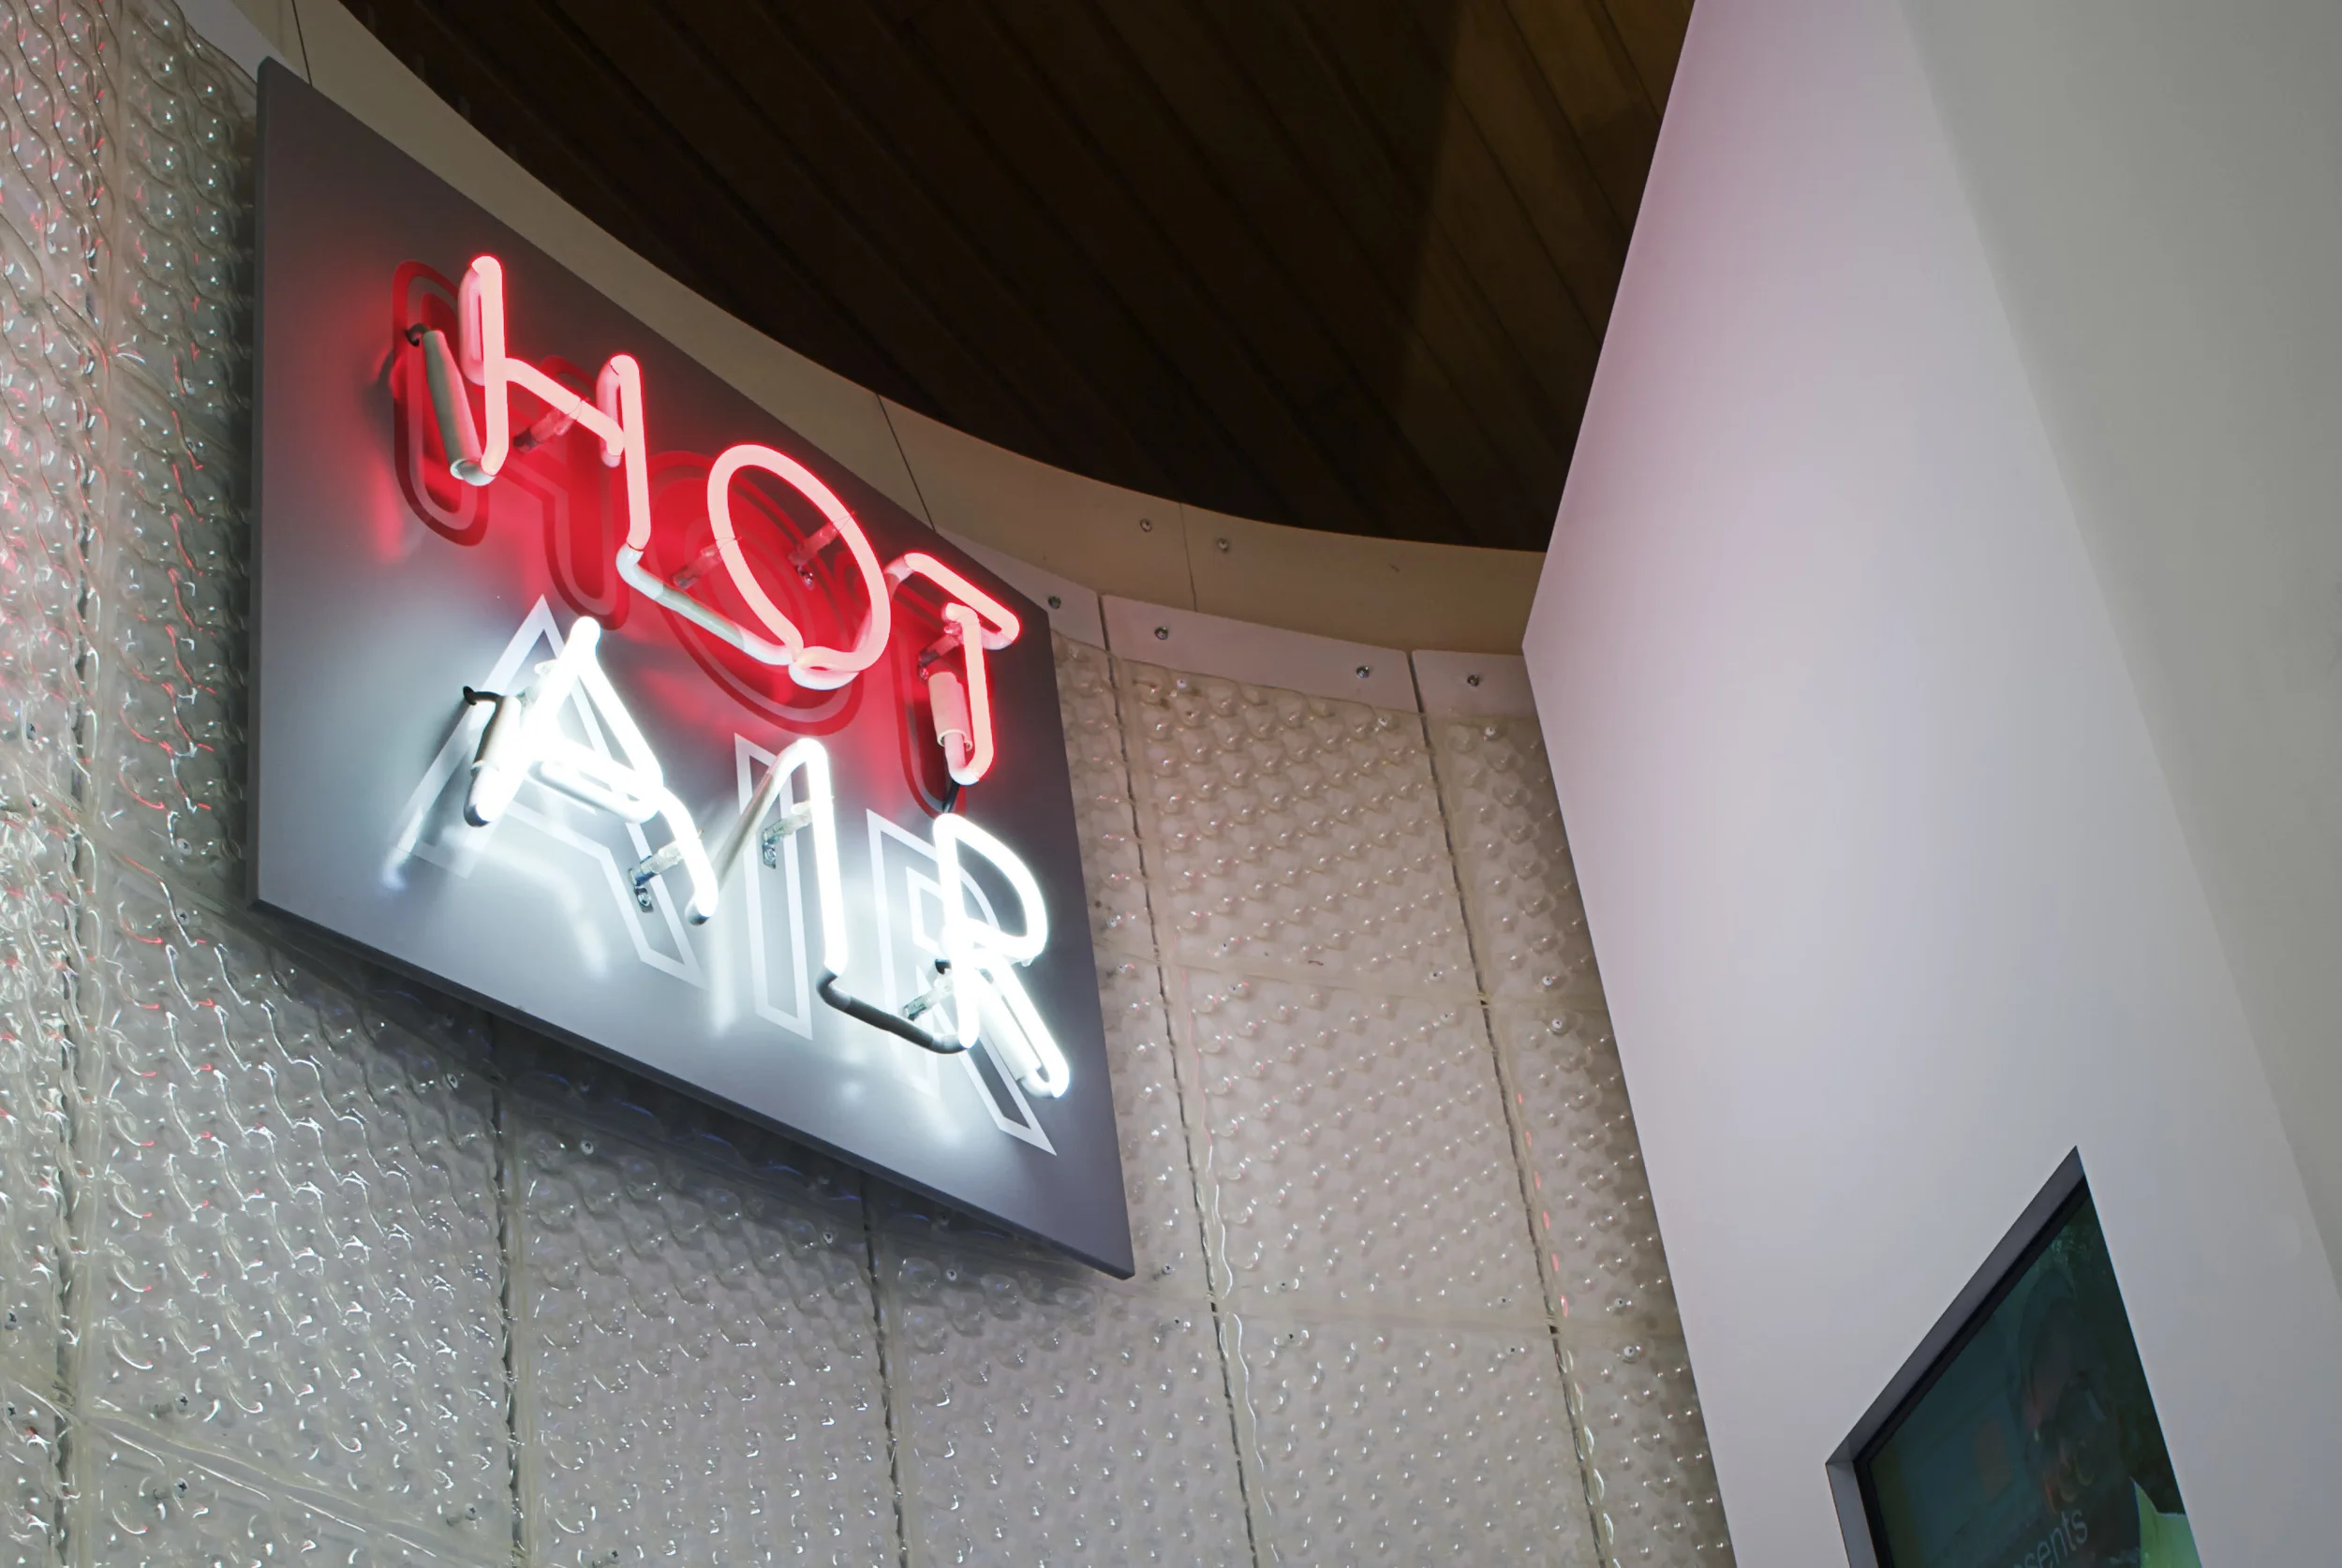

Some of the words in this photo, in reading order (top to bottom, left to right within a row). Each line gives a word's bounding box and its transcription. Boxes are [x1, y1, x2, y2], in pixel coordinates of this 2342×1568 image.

[442, 255, 1021, 786] HOT
[464, 614, 1072, 1101] AIR
[2013, 1508, 2088, 1568] sents
